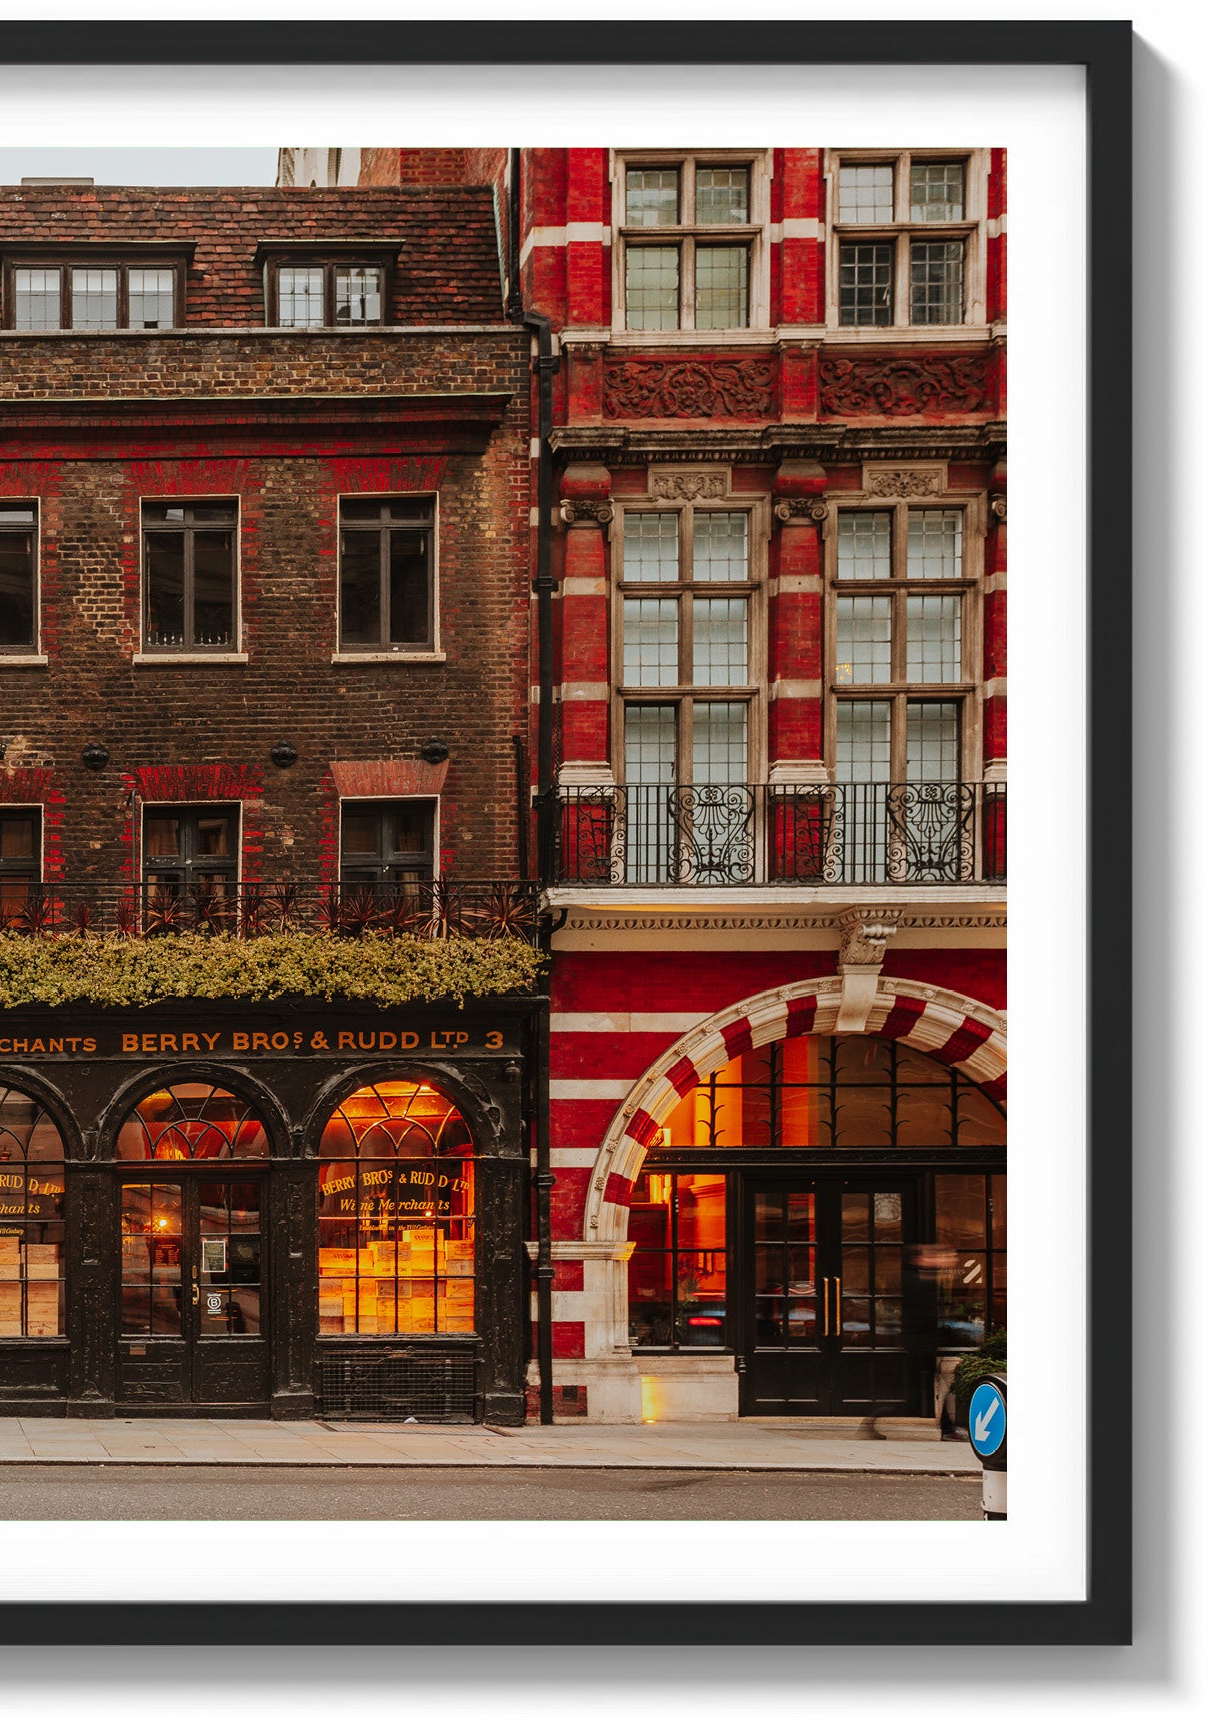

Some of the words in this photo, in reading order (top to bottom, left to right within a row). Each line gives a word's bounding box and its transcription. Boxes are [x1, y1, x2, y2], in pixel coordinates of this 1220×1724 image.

[122, 1032, 221, 1052] BERRY
[310, 1031, 330, 1050] &
[338, 1031, 420, 1050] RUDD
[484, 1031, 504, 1050] 3
[321, 1175, 356, 1197] BERRY
[398, 1173, 407, 1184] &
[410, 1171, 449, 1188] RUDD
[340, 1199, 374, 1211] Wine
[378, 1199, 450, 1211] Merchants
